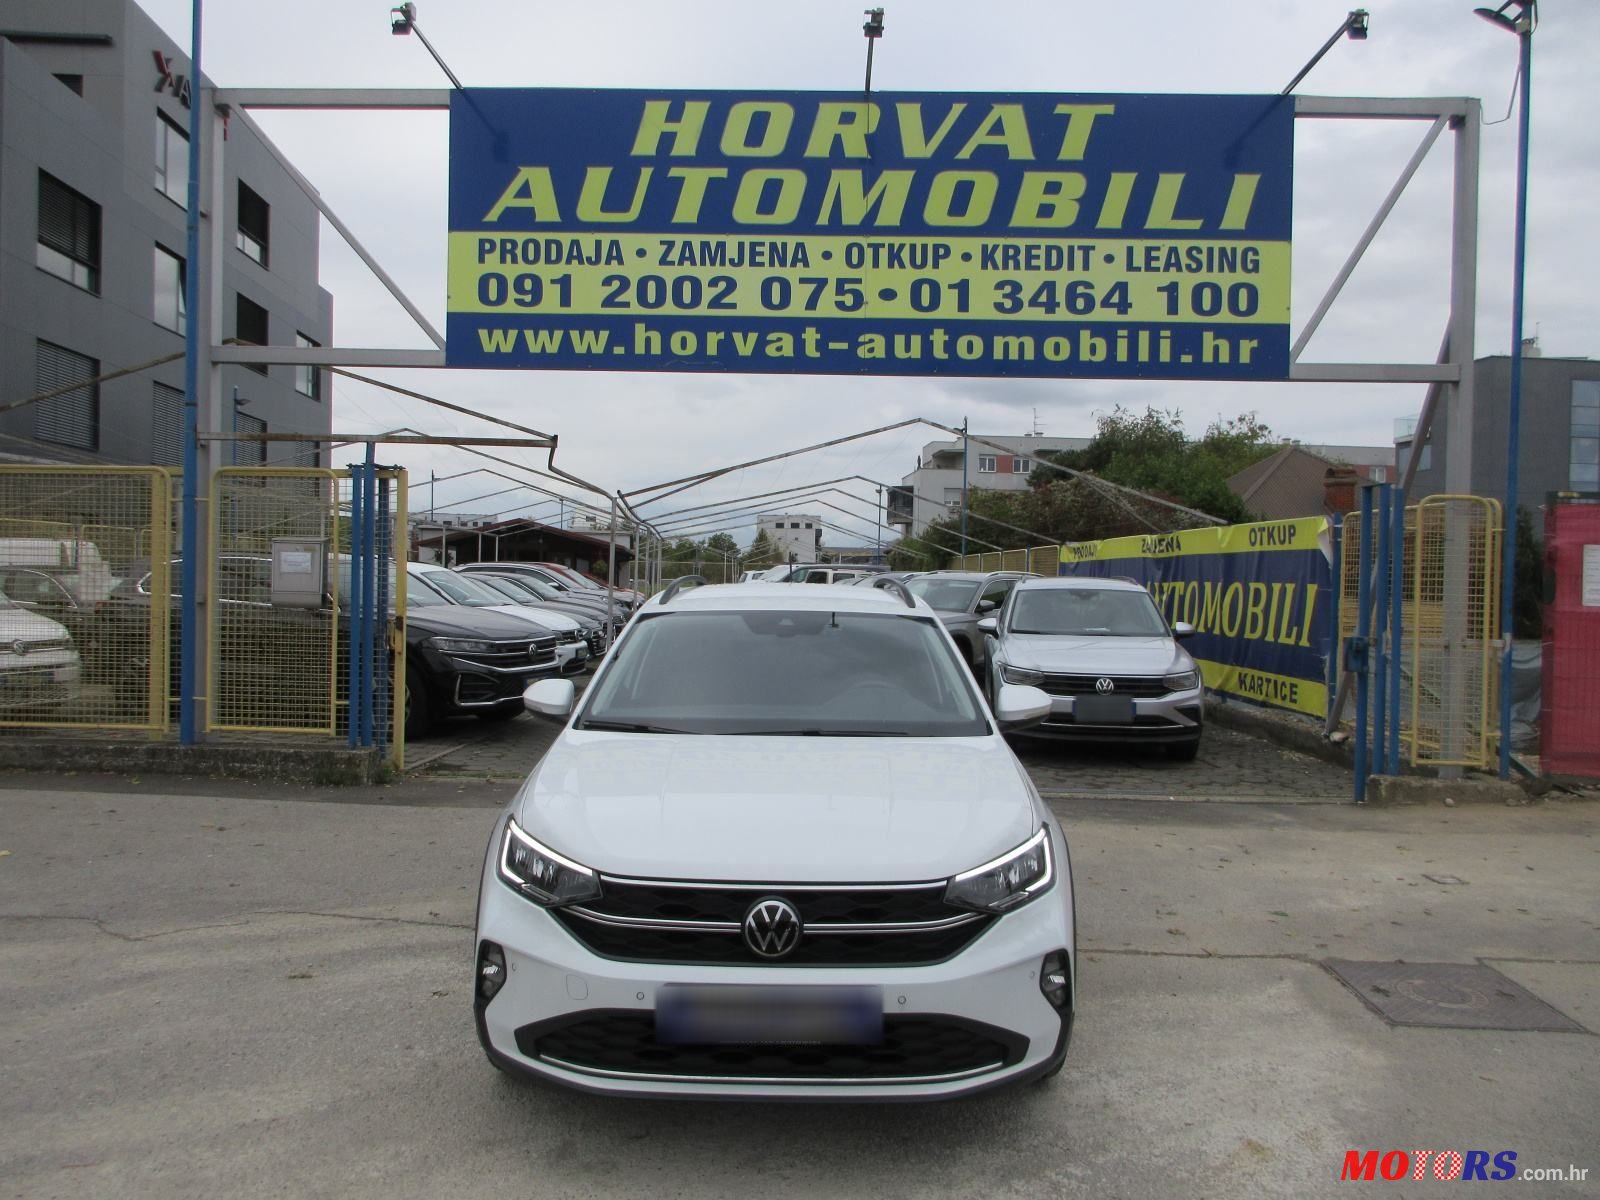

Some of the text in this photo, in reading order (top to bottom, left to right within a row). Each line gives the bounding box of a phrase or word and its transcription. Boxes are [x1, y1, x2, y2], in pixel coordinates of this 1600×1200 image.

[630, 100, 1115, 161] HORVAT
[482, 166, 1262, 231] AUTOMOBILI
[478, 238, 1261, 274] PRODAJA ZAMJENA OTKUP KREDIT LEASING
[477, 273, 573, 308] 091
[600, 275, 739, 311] 2002
[993, 280, 1133, 316] 3464
[1156, 282, 1260, 318] 100
[477, 323, 1259, 362] www.horvat-automobili.hr
[1249, 524, 1297, 546] OTKUP
[1238, 672, 1298, 704] KARTICE
